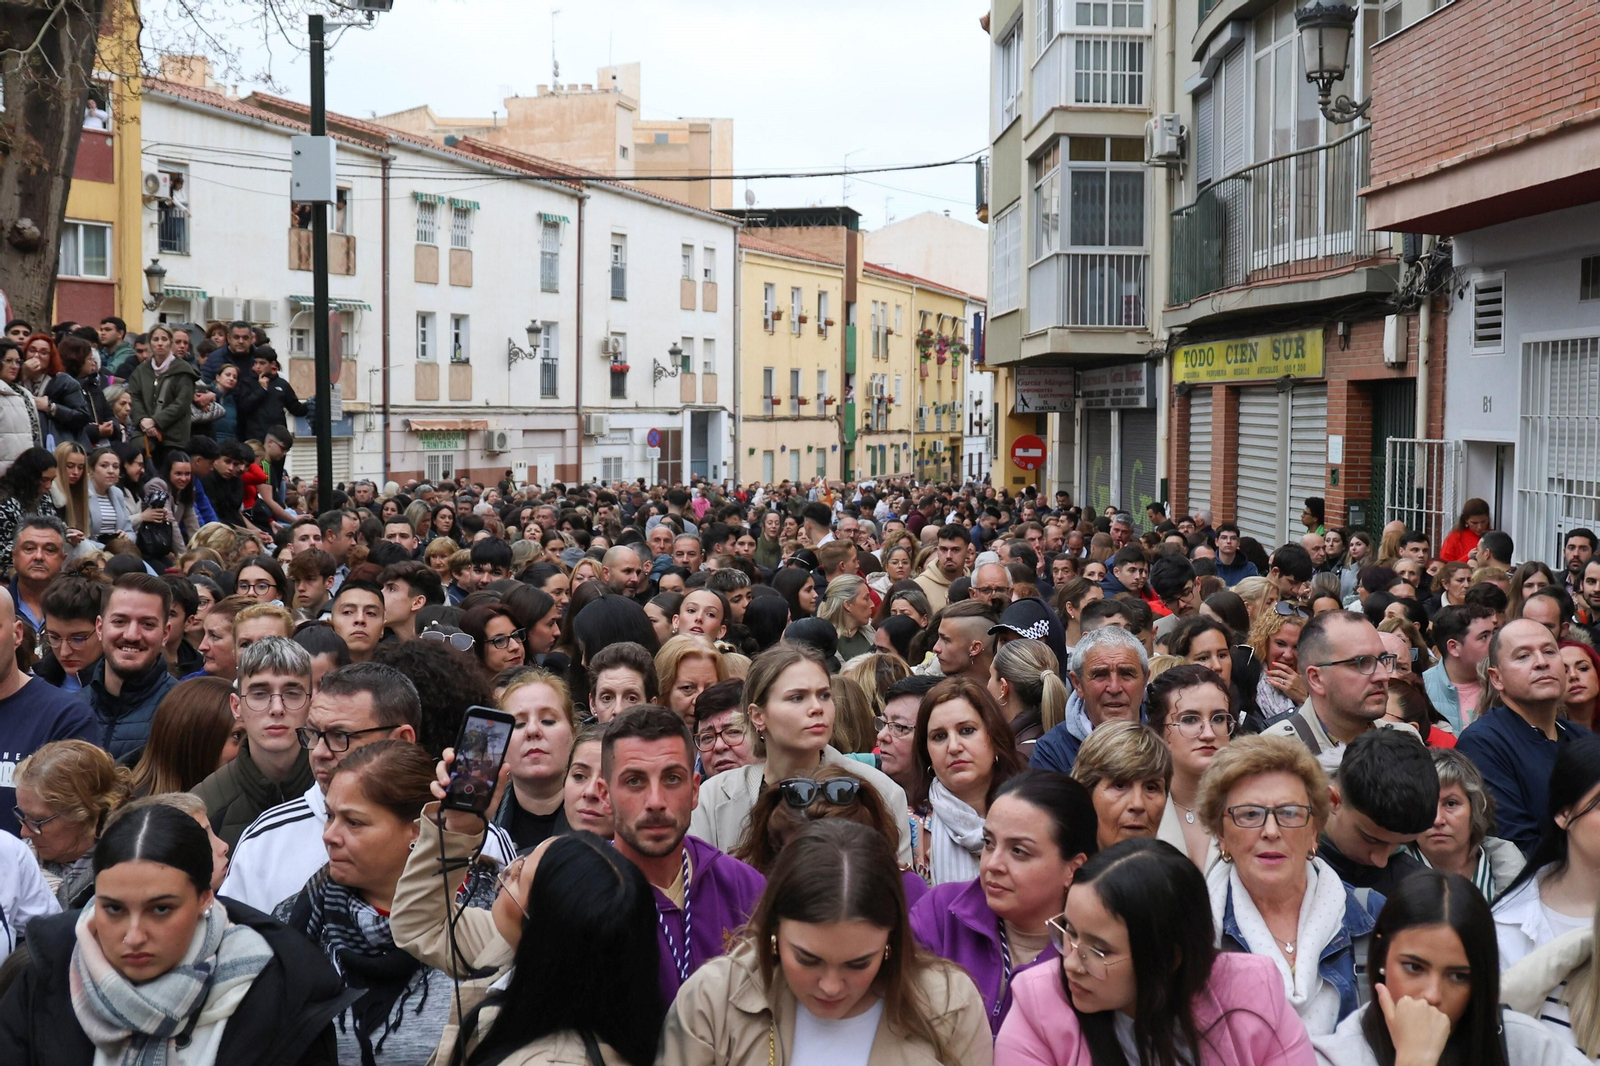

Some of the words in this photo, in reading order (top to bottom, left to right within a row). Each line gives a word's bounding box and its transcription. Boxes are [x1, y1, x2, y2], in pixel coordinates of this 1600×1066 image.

[1183, 347, 1215, 368] TODO
[1225, 341, 1259, 365] CIEN
[1272, 335, 1306, 361] SUR
[422, 440, 459, 450] TRINITARIA
